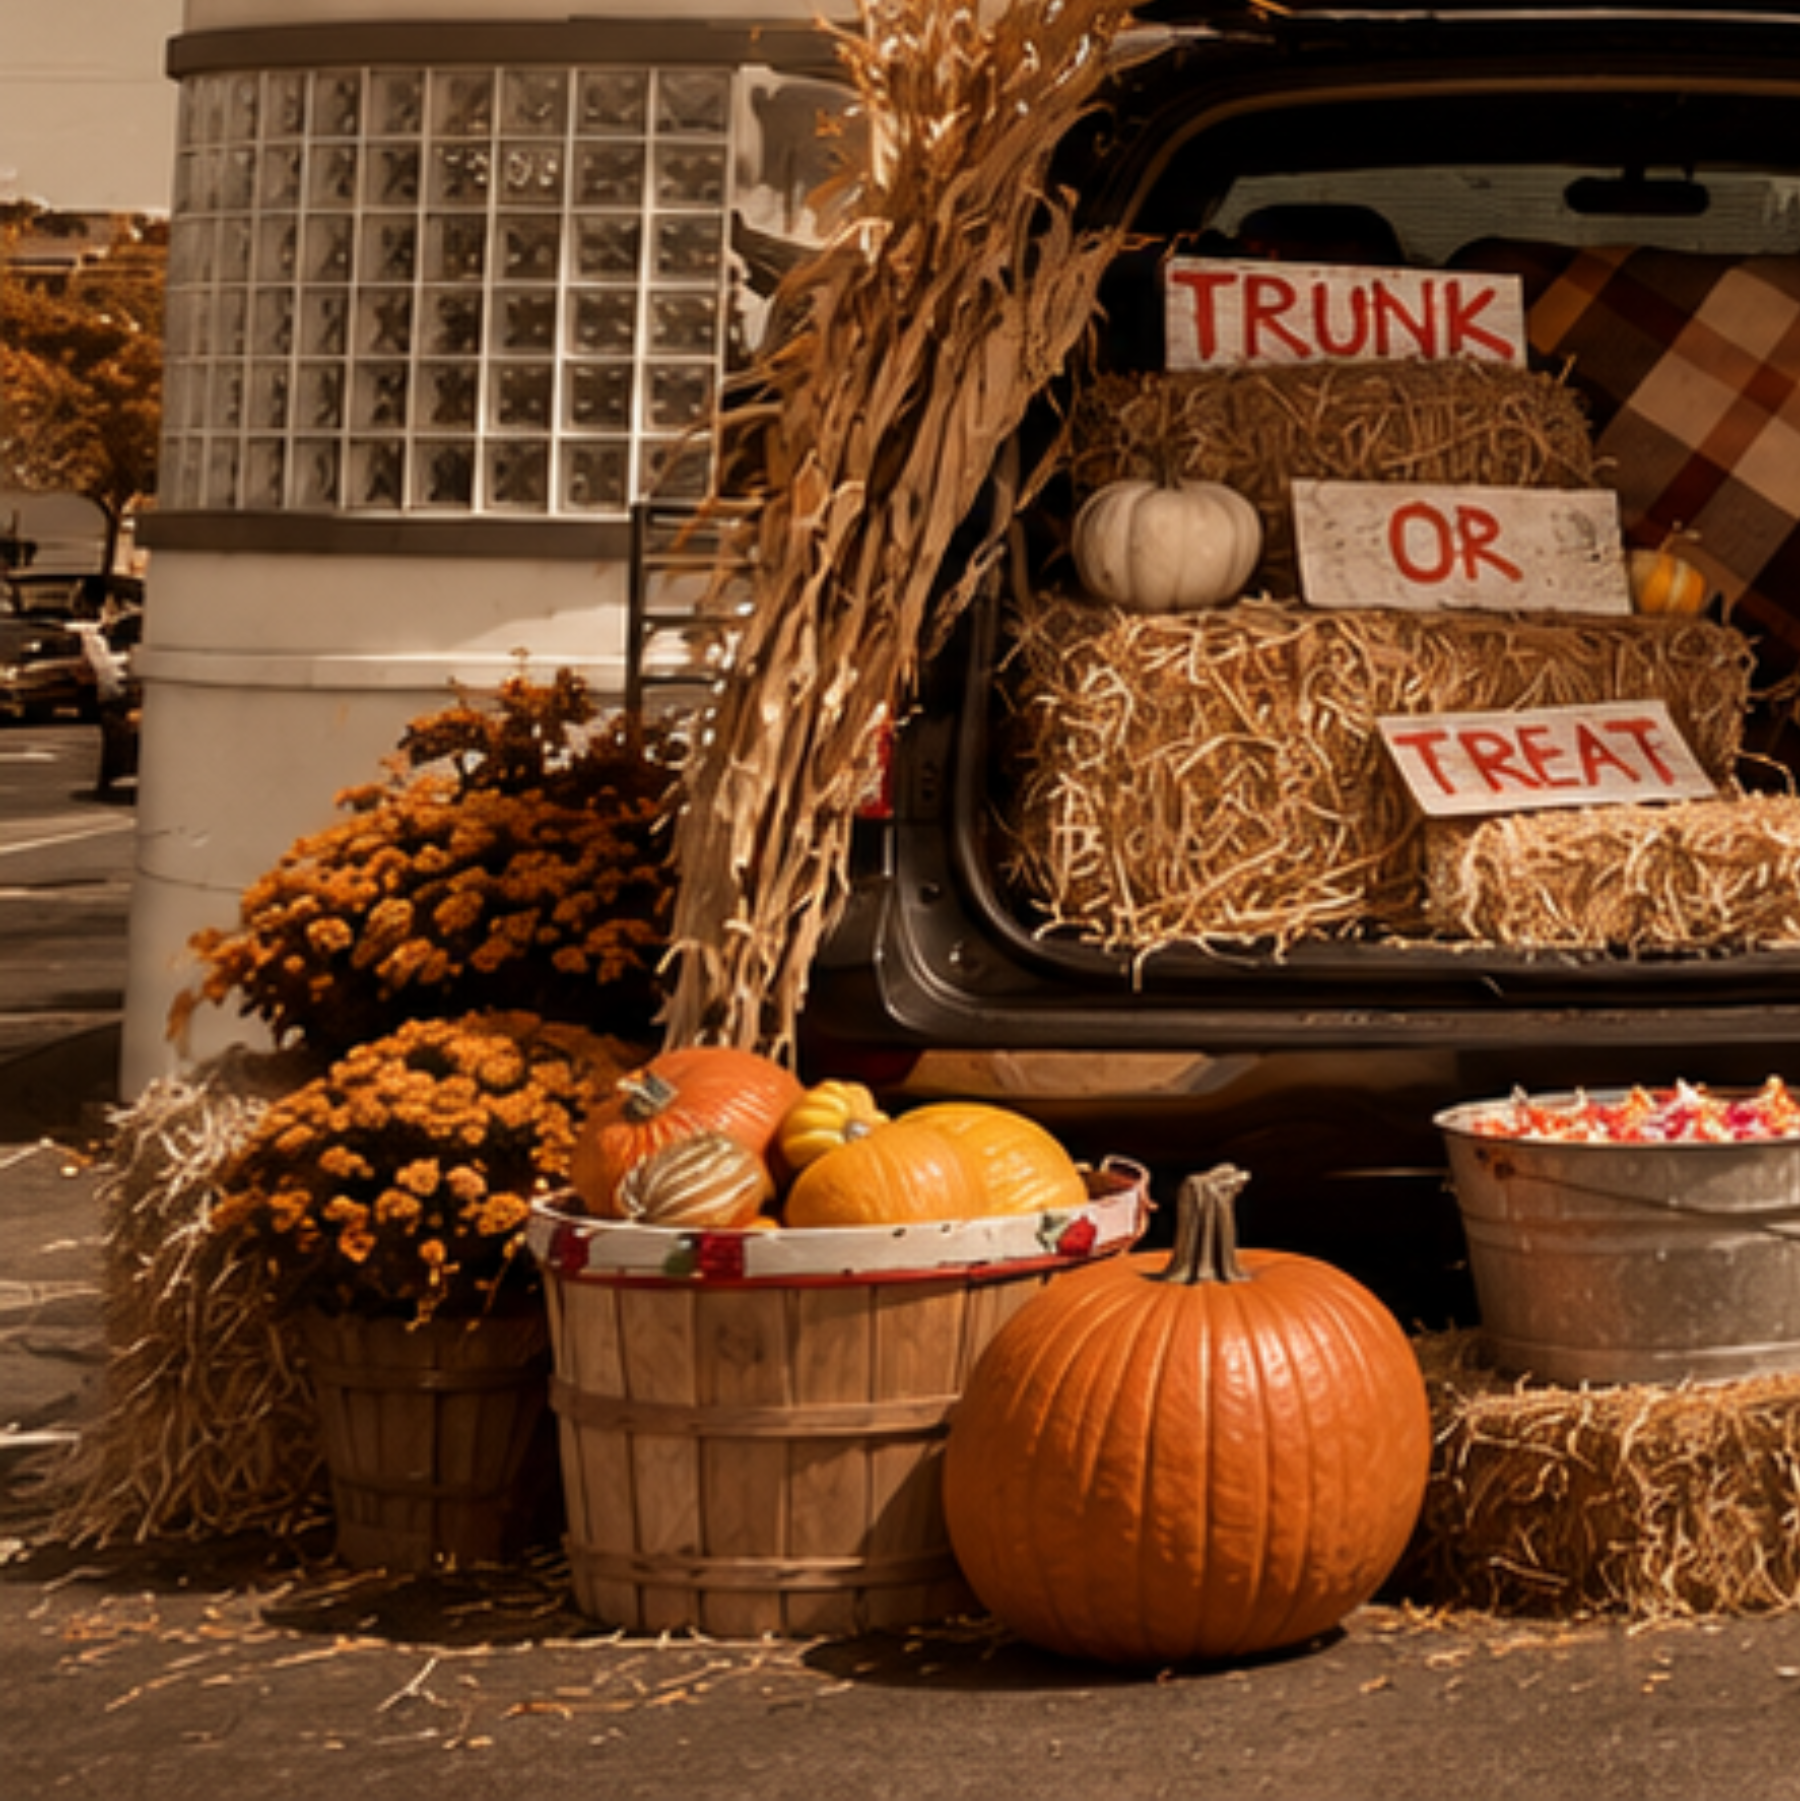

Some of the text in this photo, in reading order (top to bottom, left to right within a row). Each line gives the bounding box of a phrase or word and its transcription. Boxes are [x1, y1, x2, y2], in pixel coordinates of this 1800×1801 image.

[1171, 270, 1515, 360] TRUNK
[1387, 501, 1523, 584] OR
[1391, 716, 1679, 796] TREAT
